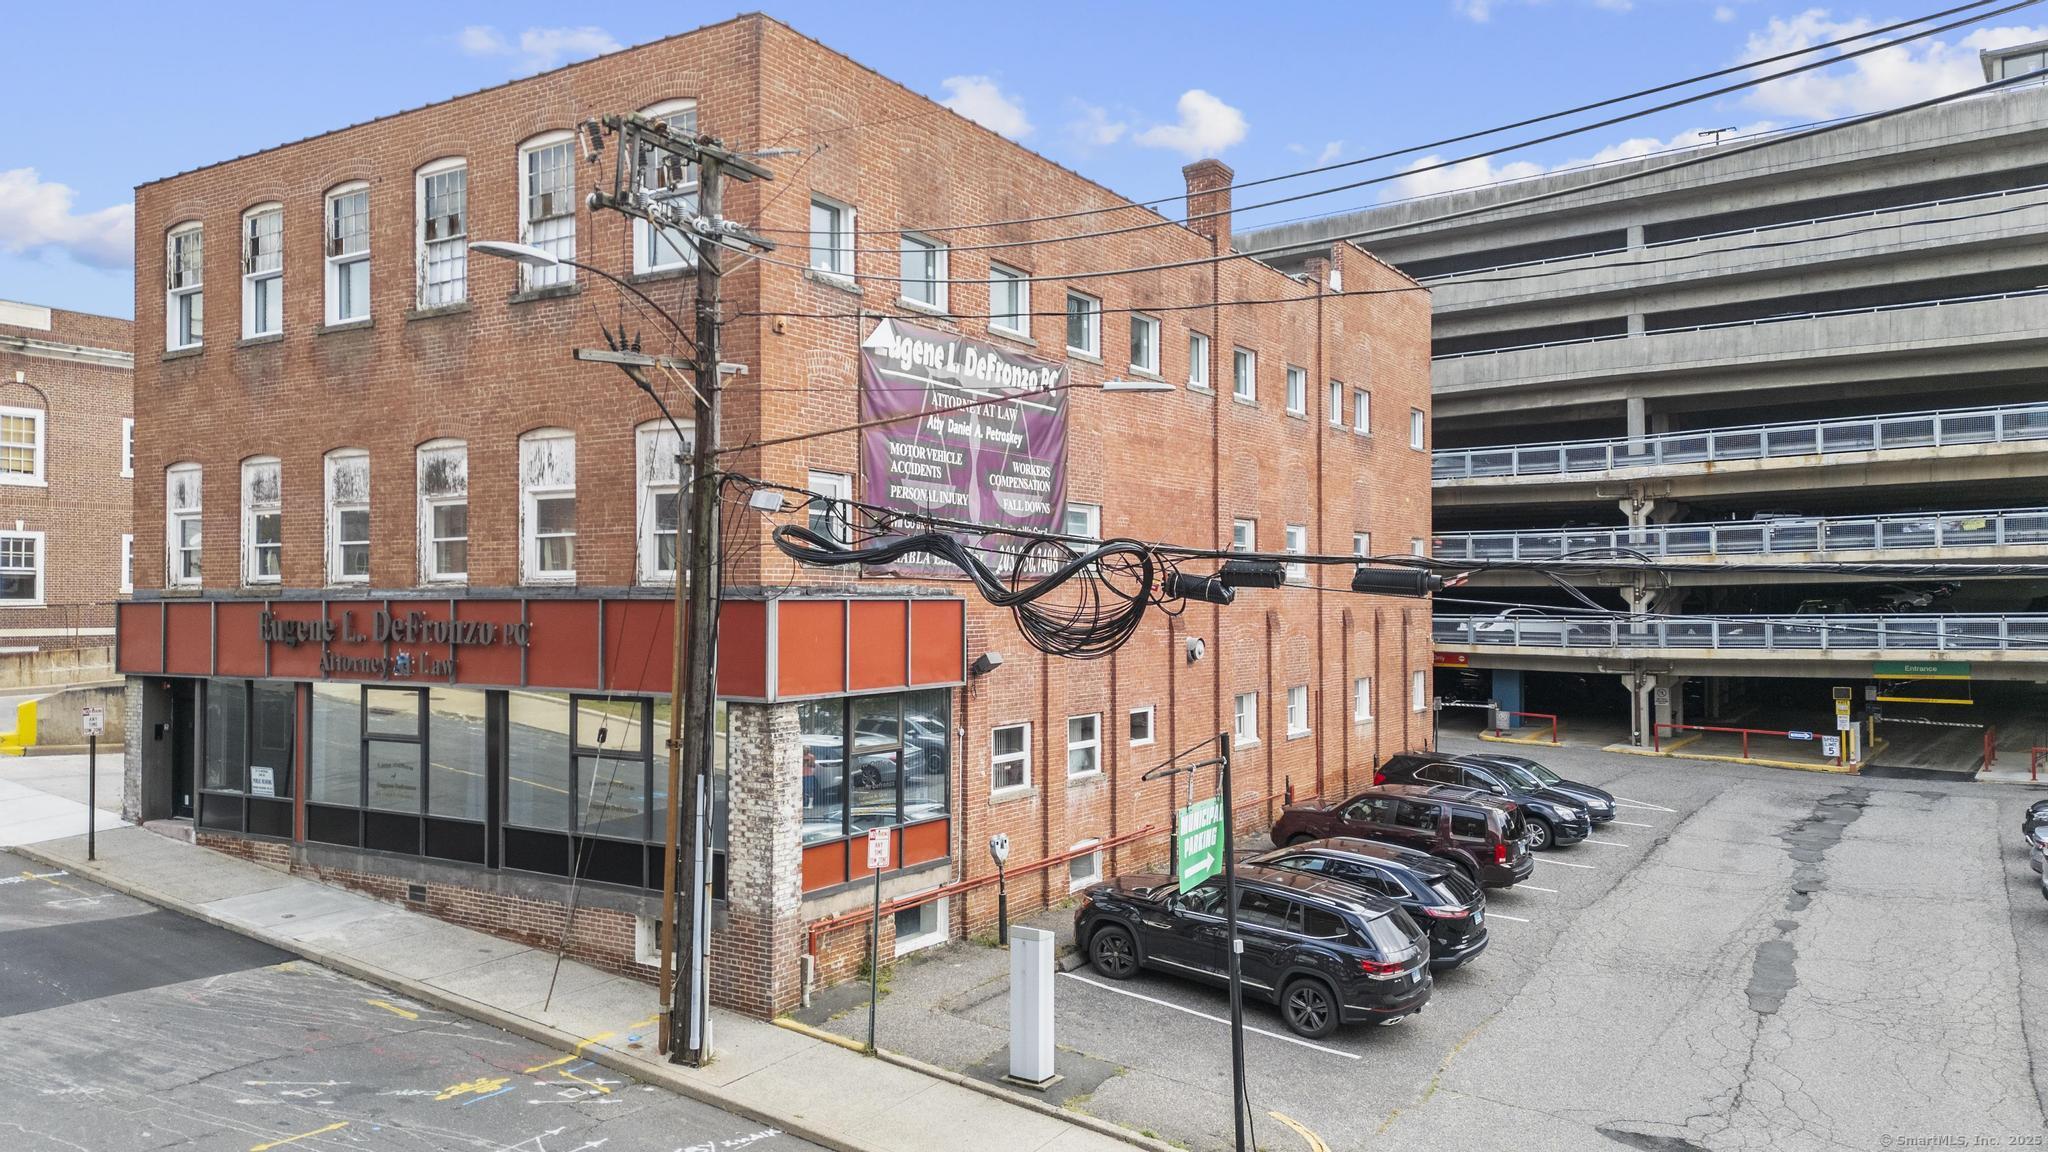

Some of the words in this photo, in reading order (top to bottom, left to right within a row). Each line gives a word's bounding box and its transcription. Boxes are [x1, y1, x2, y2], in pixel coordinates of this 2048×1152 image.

[946, 343, 960, 373] L.
[964, 347, 1038, 393] DeFronzo
[1040, 366, 1059, 397] PC
[931, 391, 983, 415] ATTORNEY
[983, 402, 997, 418] AT
[998, 405, 1018, 422] LAW
[927, 415, 944, 435] Atty
[948, 419, 971, 436] Daniel
[974, 424, 984, 437] A.
[985, 425, 1023, 448] Petroskey
[890, 441, 925, 461] MOTOR
[925, 448, 963, 465] VEHICLE
[890, 460, 942, 479] ACCIDENTS
[1012, 461, 1051, 478] WORKERS
[989, 474, 1051, 491] COMPENSATION
[890, 485, 938, 503] PERSONAL
[939, 492, 969, 507] INJURY
[1003, 498, 1024, 511] FALL
[1025, 501, 1051, 514] DOWNS
[894, 550, 931, 564] ABLA
[258, 610, 335, 648] Eugene
[372, 610, 495, 646] DeFronzo
[502, 622, 529, 647] PC
[320, 650, 387, 676] Attorney
[1904, 664, 1938, 672] Entrance
[1828, 746, 1835, 755] 5
[1184, 826, 1218, 858] PARKING
